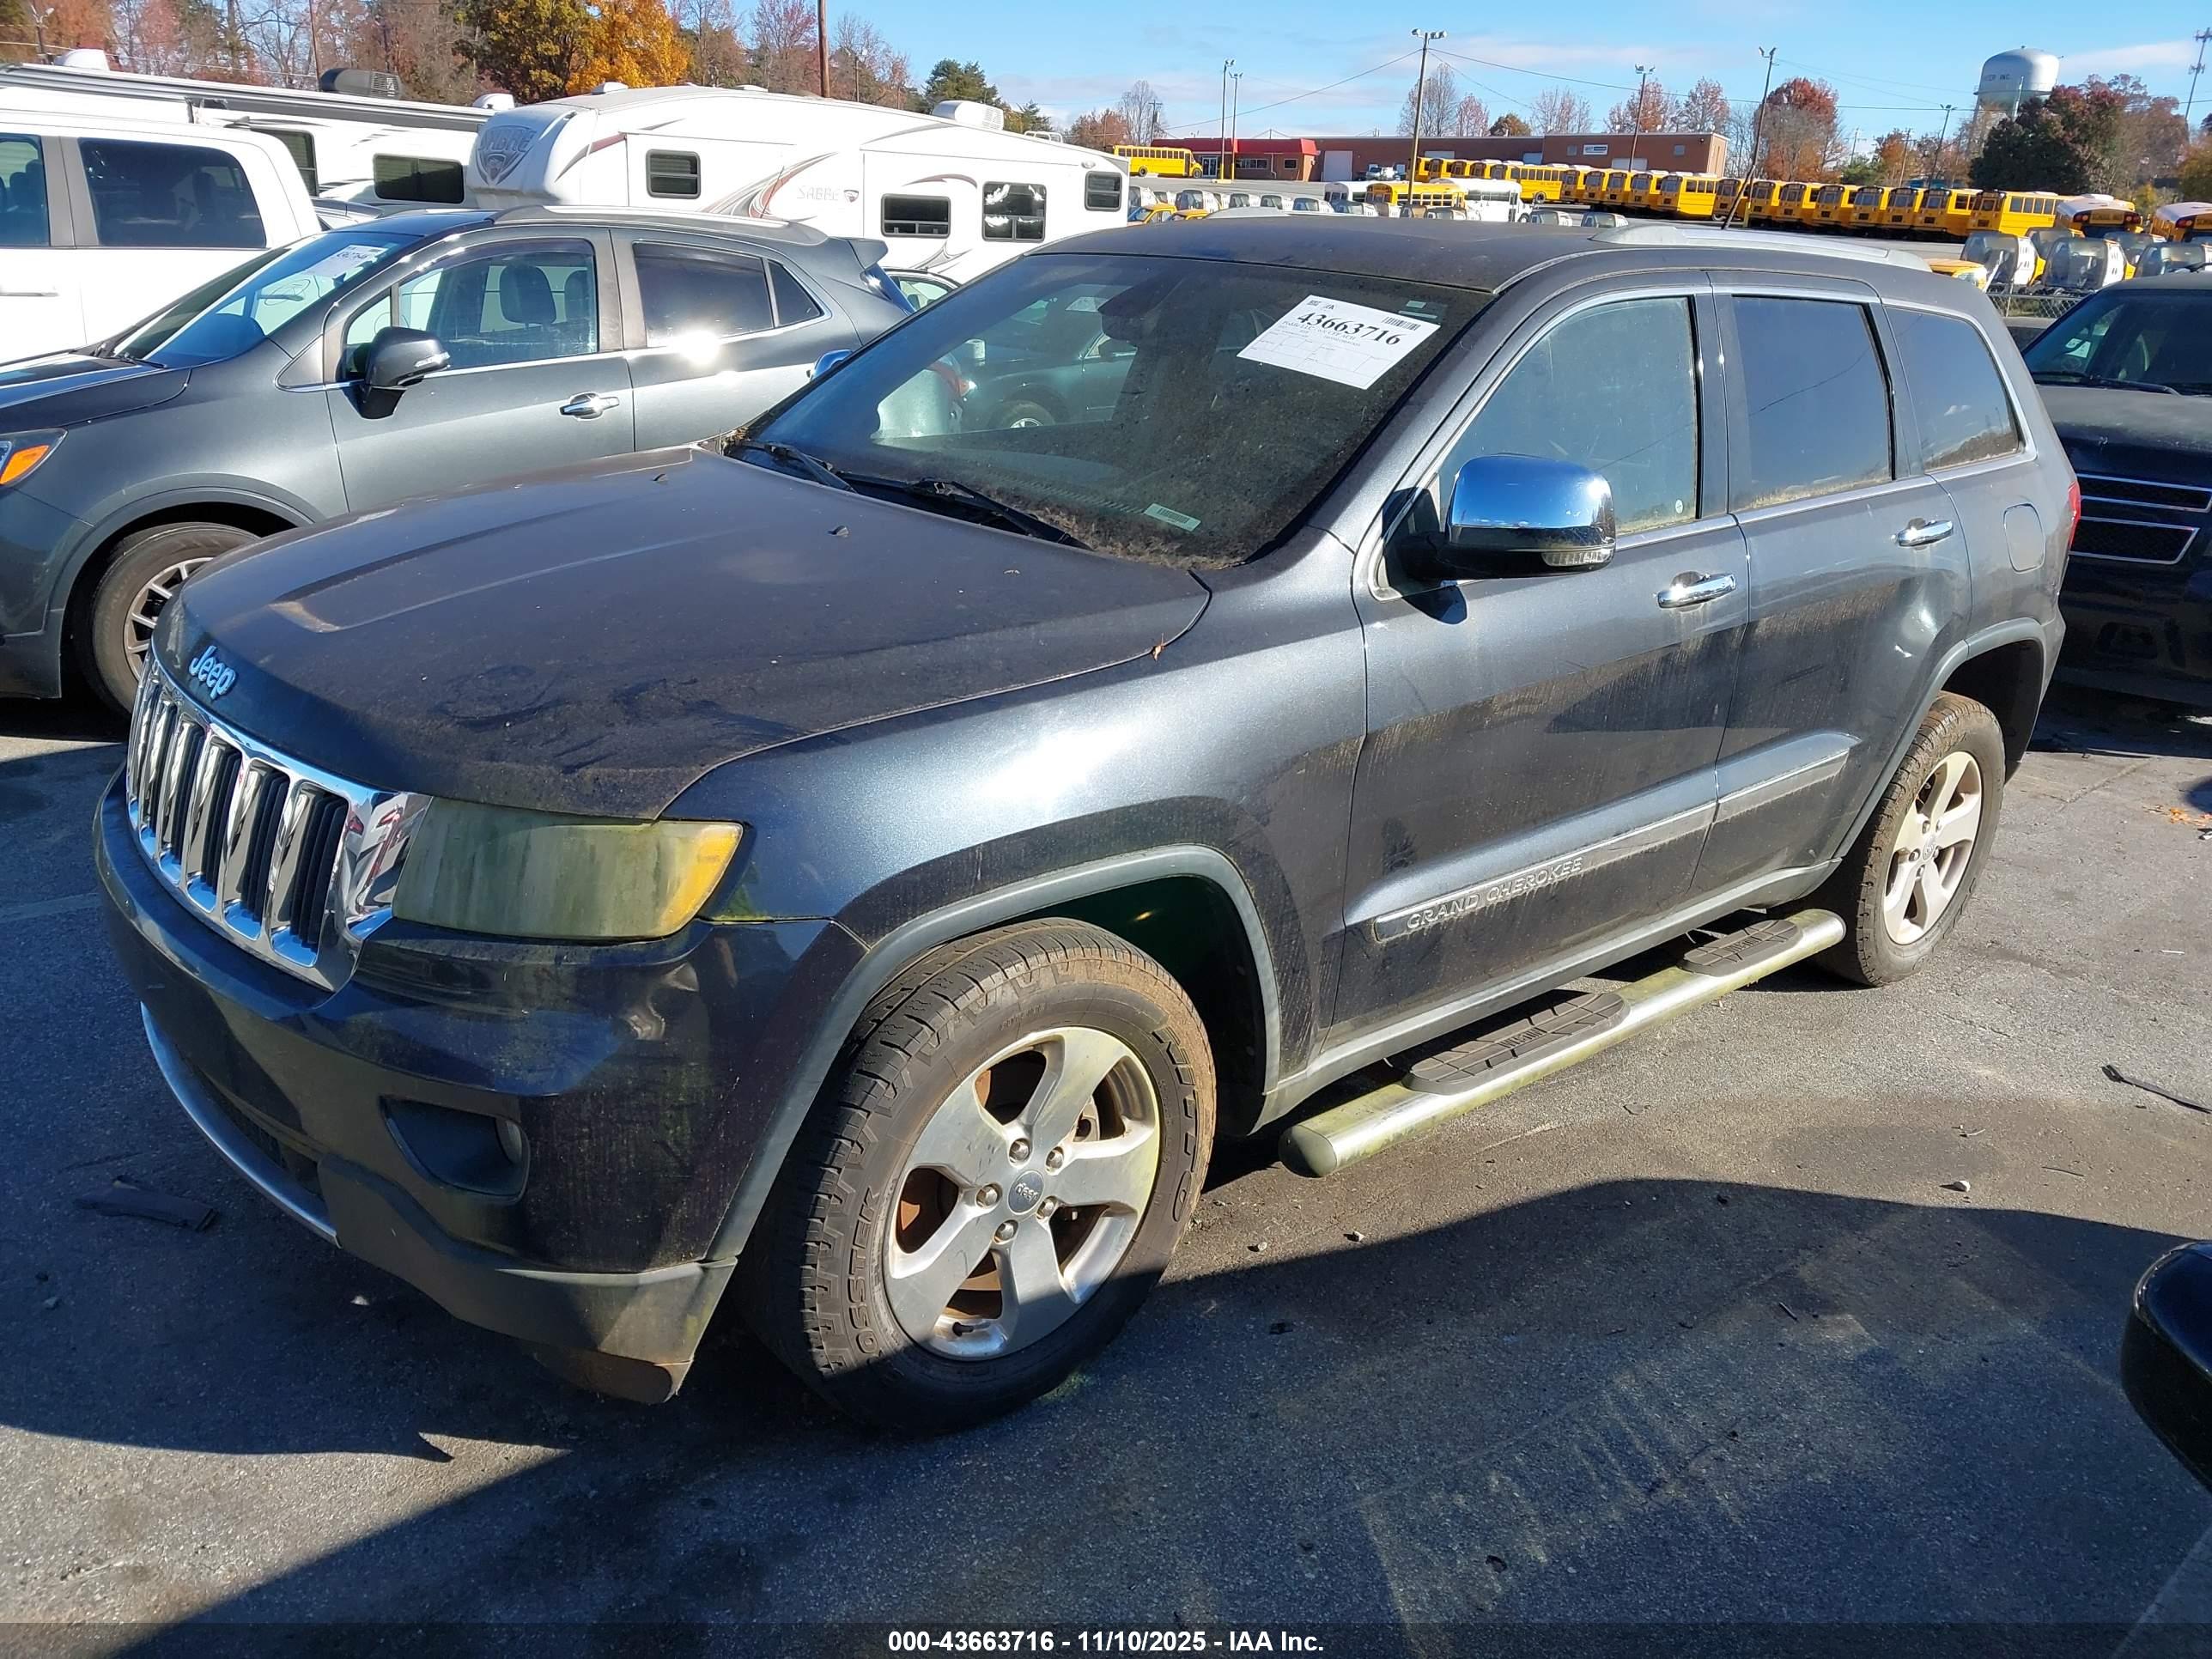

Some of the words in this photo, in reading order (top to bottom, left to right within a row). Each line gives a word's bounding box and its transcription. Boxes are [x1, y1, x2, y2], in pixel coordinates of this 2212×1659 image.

[1297, 312, 1404, 345] 43663716
[189, 645, 236, 700] Jeep
[1406, 894, 1480, 929] GRAND
[1486, 857, 1584, 902] CHEROKEE
[1152, 1026, 1200, 1222] NITTO
